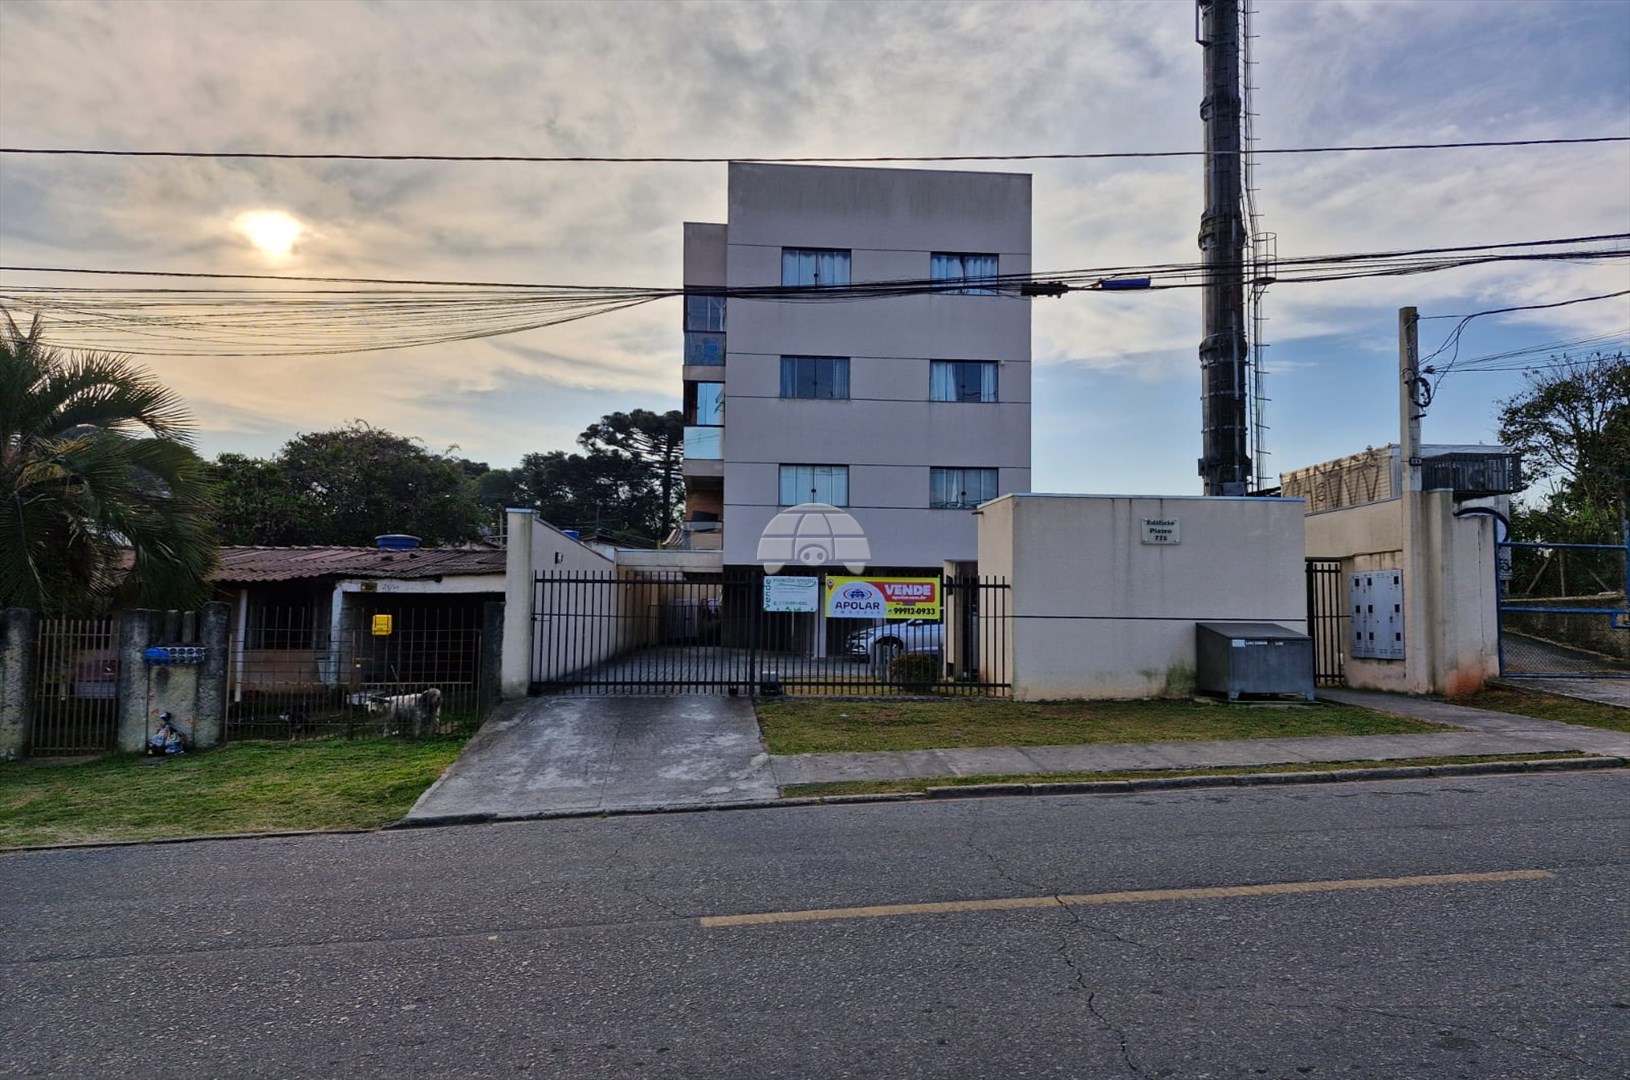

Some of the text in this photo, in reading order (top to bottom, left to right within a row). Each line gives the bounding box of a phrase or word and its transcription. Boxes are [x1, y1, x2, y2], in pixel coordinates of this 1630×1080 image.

[884, 584, 931, 596] VENDE
[835, 602, 880, 610] APOLAR
[893, 607, 936, 615] 99912-0933
